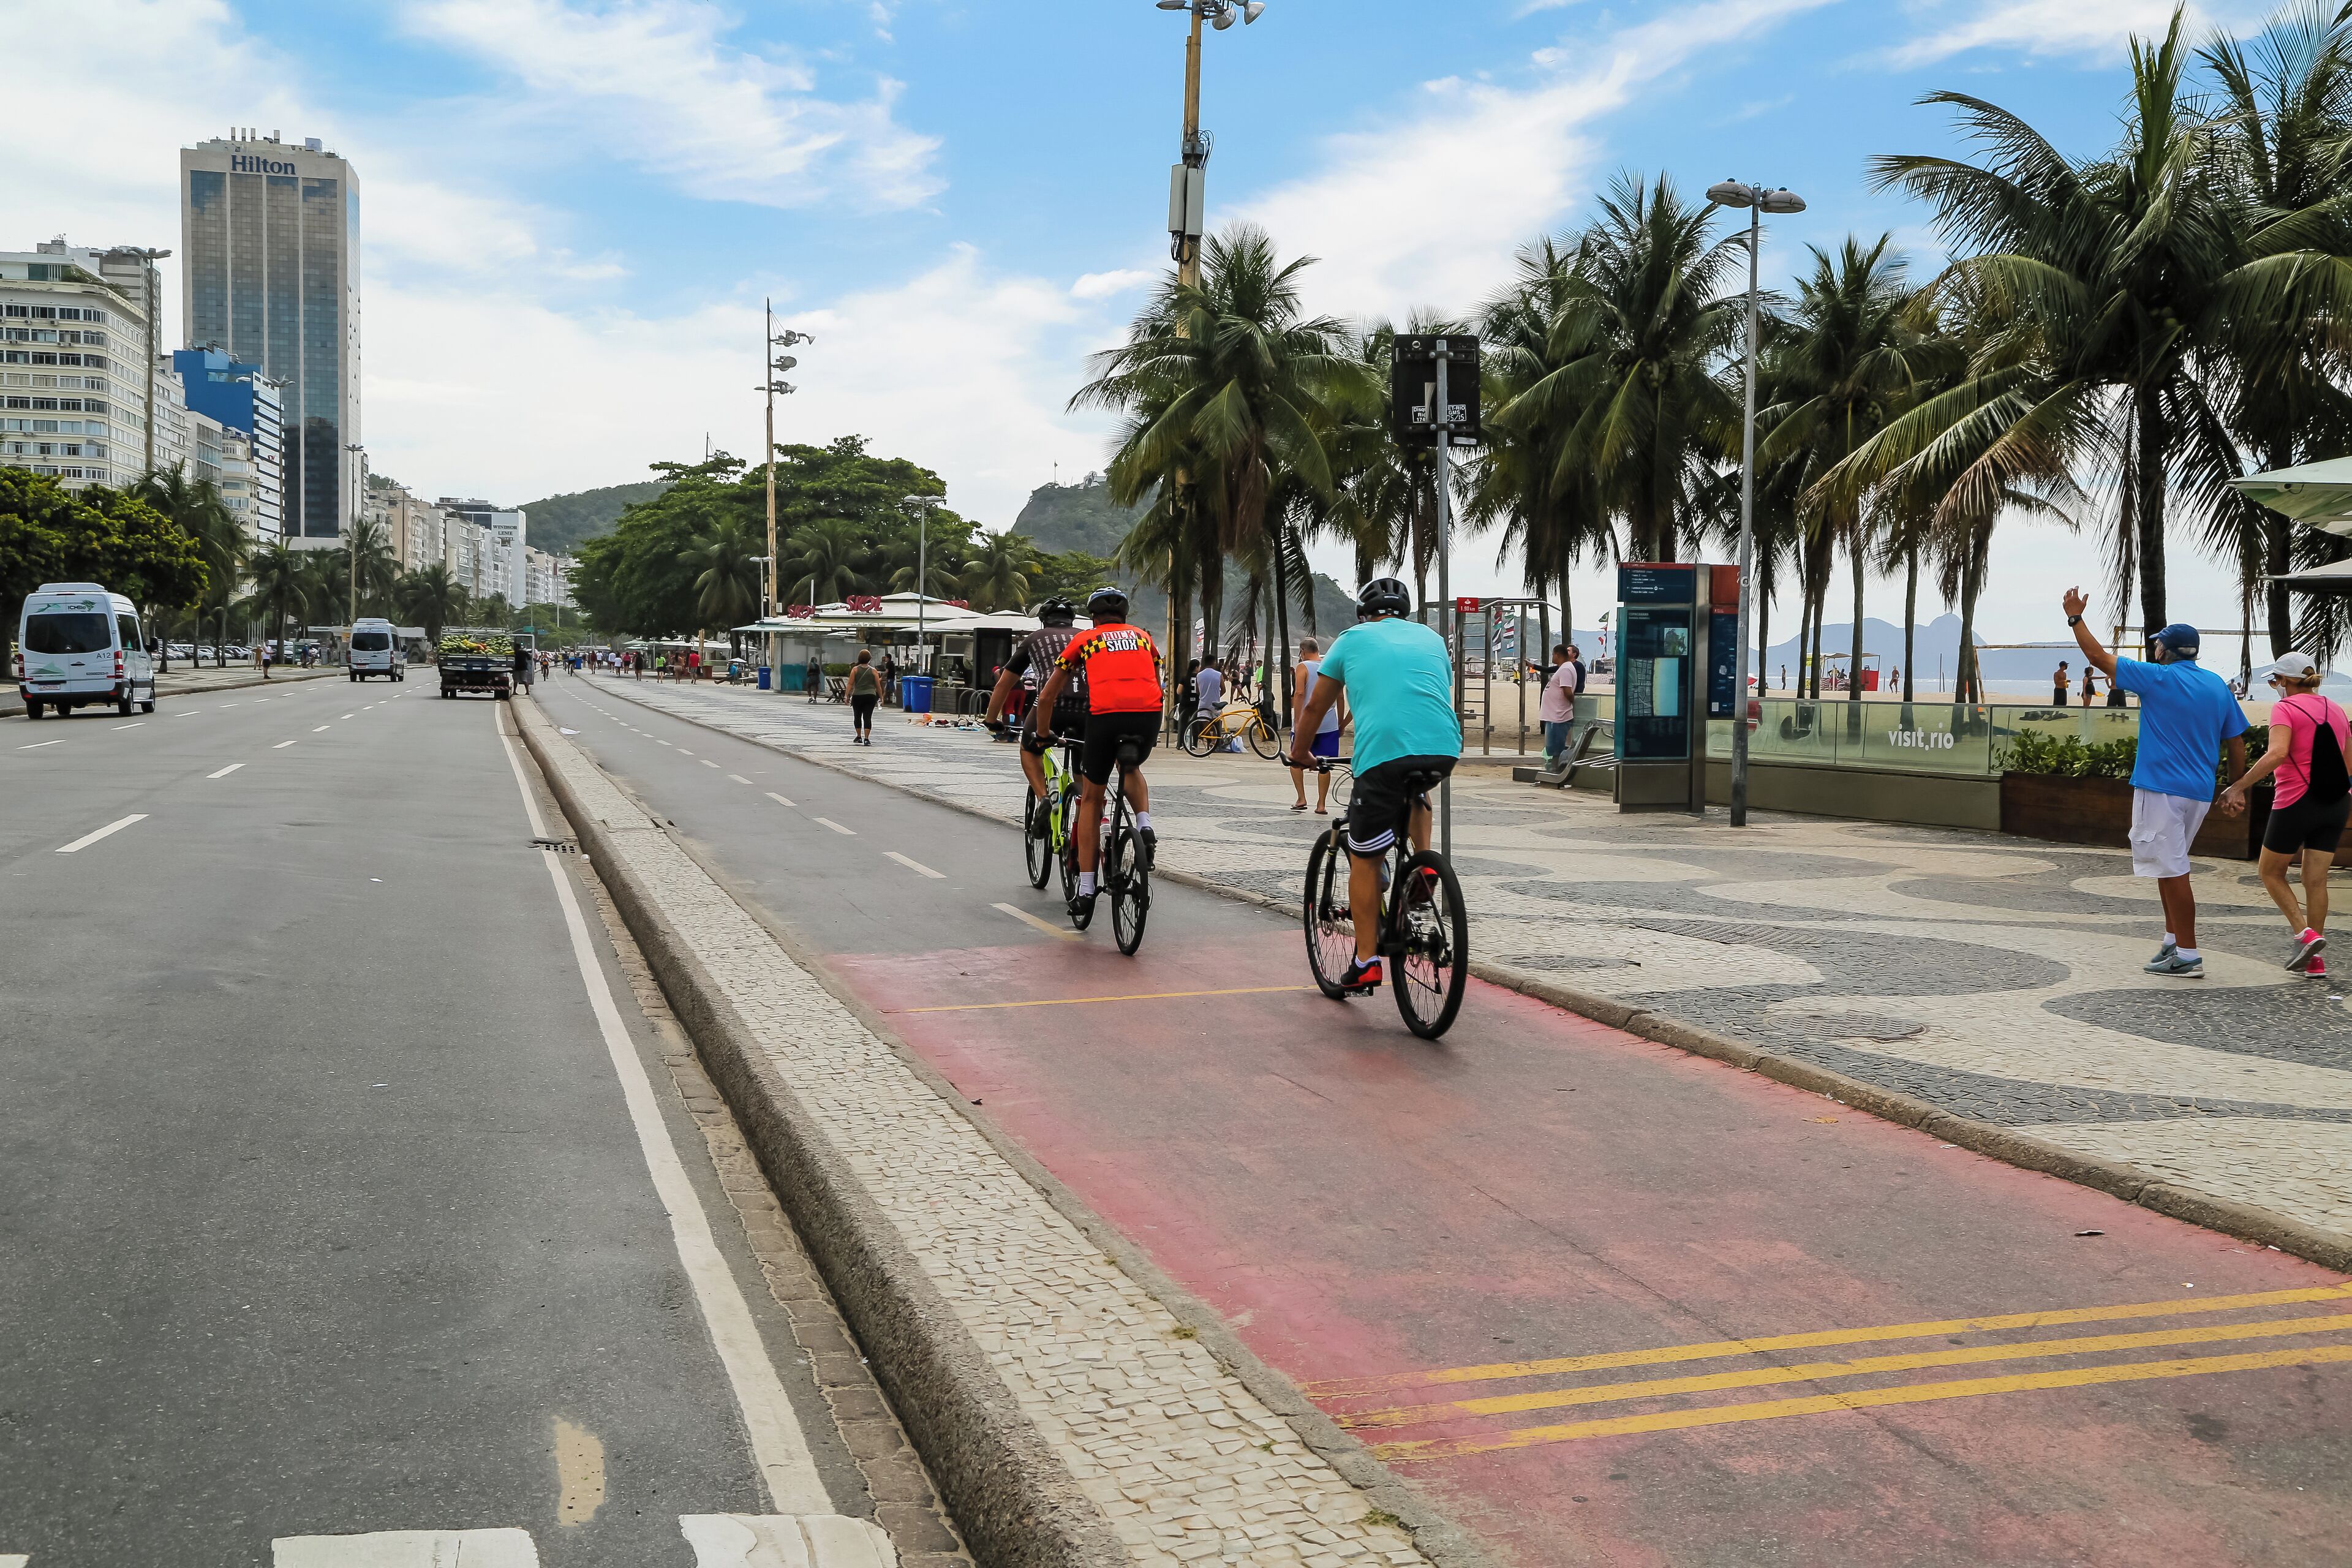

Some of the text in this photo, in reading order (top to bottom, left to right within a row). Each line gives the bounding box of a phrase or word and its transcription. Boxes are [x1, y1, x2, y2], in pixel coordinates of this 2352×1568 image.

[232, 155, 295, 175] Hilton
[846, 595, 883, 612] SKOL
[787, 605, 816, 619] SKOL
[1104, 631, 1135, 640] ROCK
[1107, 639, 1137, 652] SHOX
[1888, 722, 1954, 751] visit.rio
